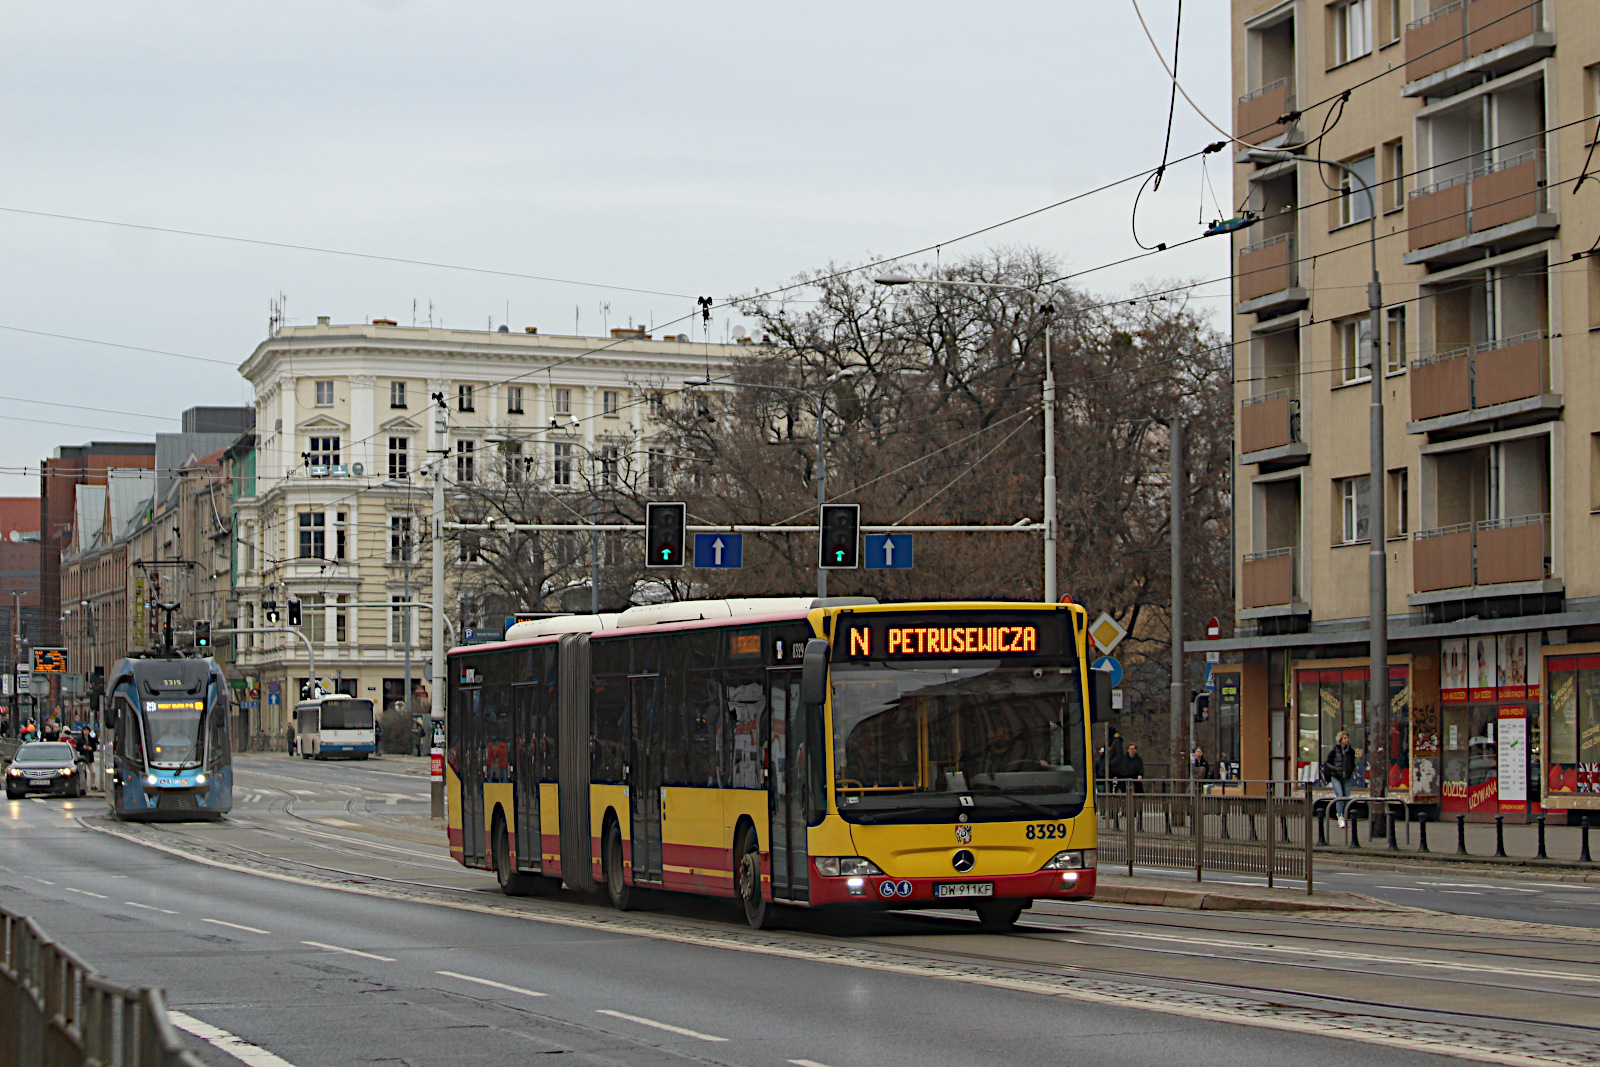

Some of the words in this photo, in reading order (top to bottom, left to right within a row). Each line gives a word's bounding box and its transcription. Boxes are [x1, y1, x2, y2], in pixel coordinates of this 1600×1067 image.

[850, 627, 869, 656] N
[888, 626, 1037, 654] PETRUSEWICZA
[1469, 780, 1497, 810] UŻYWANA
[1026, 823, 1067, 840] 8329
[941, 885, 956, 896] DW
[959, 884, 992, 895] 911KF
